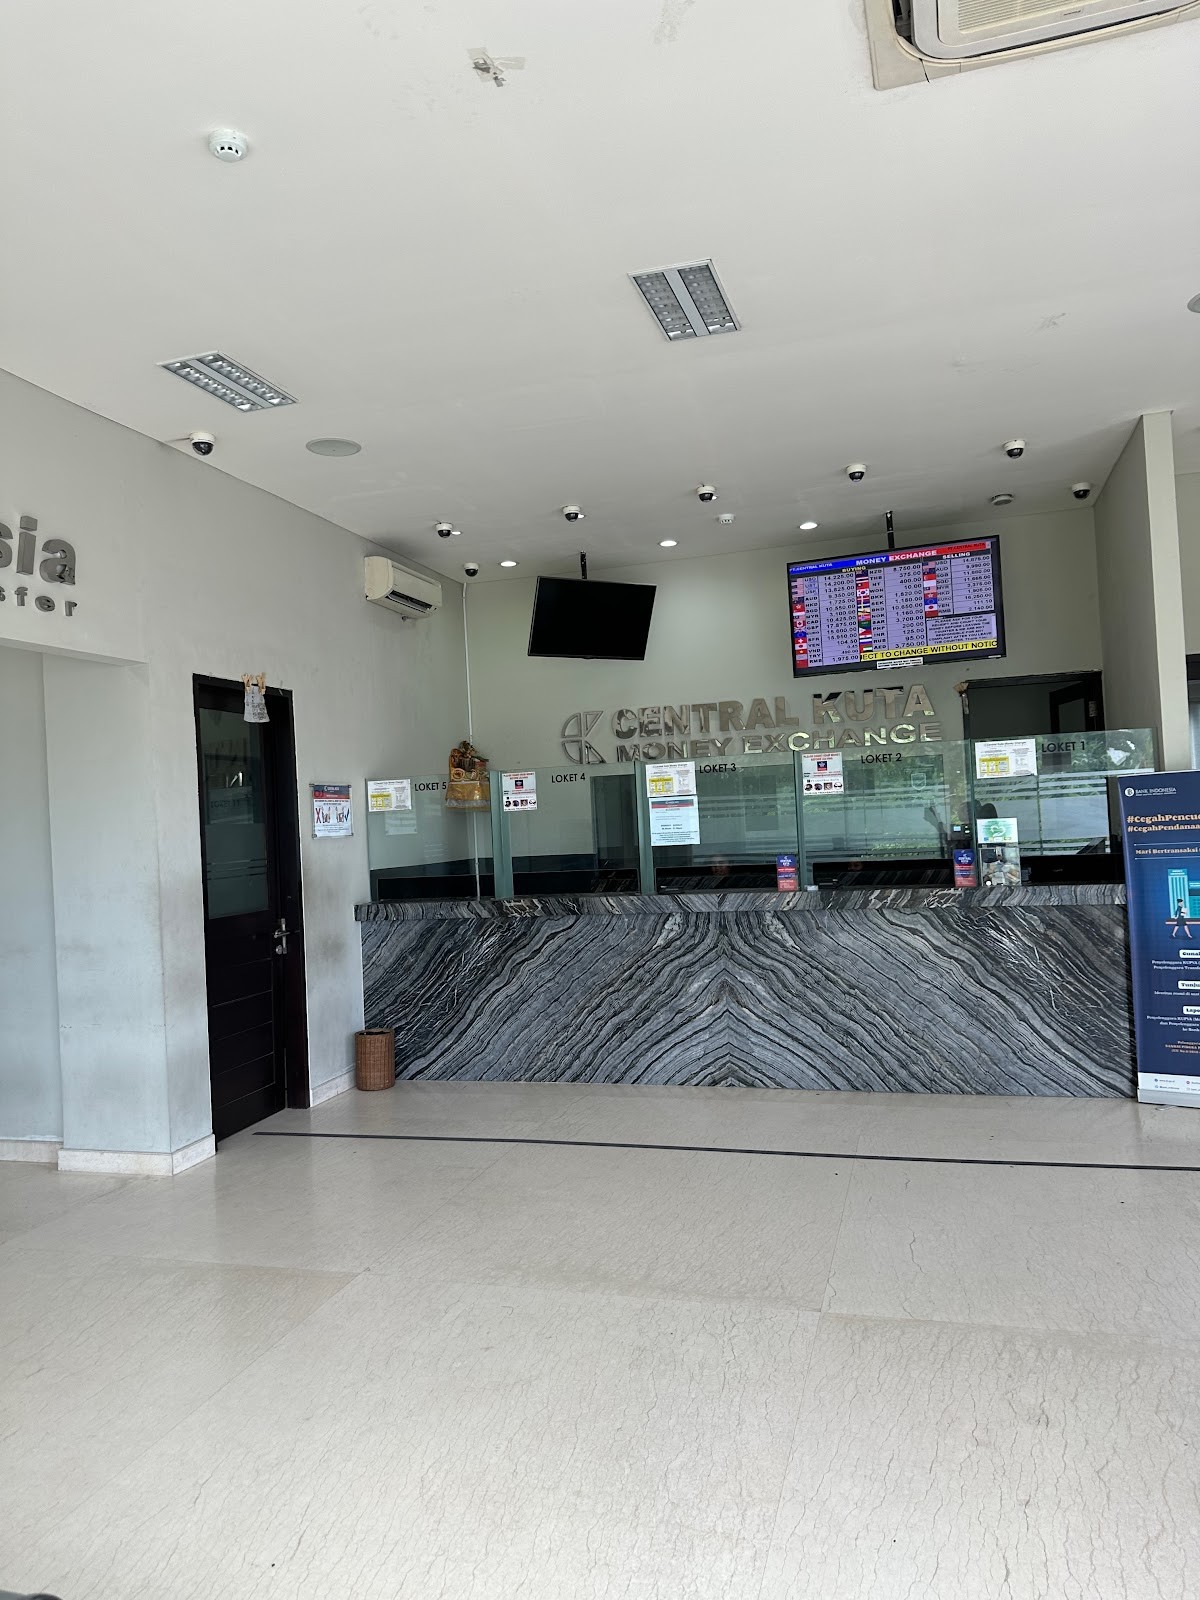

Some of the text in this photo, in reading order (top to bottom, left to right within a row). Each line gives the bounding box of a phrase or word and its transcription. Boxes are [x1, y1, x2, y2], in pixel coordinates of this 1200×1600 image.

[856, 550, 937, 565] MONEY EXCHANGE
[894, 648, 928, 656] CHANGE
[931, 644, 968, 652] WITHOUT
[611, 684, 936, 739] CENTRAL KUTA
[616, 722, 942, 762] MONEY EXCHANGE
[1042, 741, 1085, 752] LOKET 1
[861, 752, 902, 764] LOKET 2
[700, 763, 736, 773] LOKET 3
[552, 774, 578, 783] LOKET
[414, 782, 440, 791] LOKET
